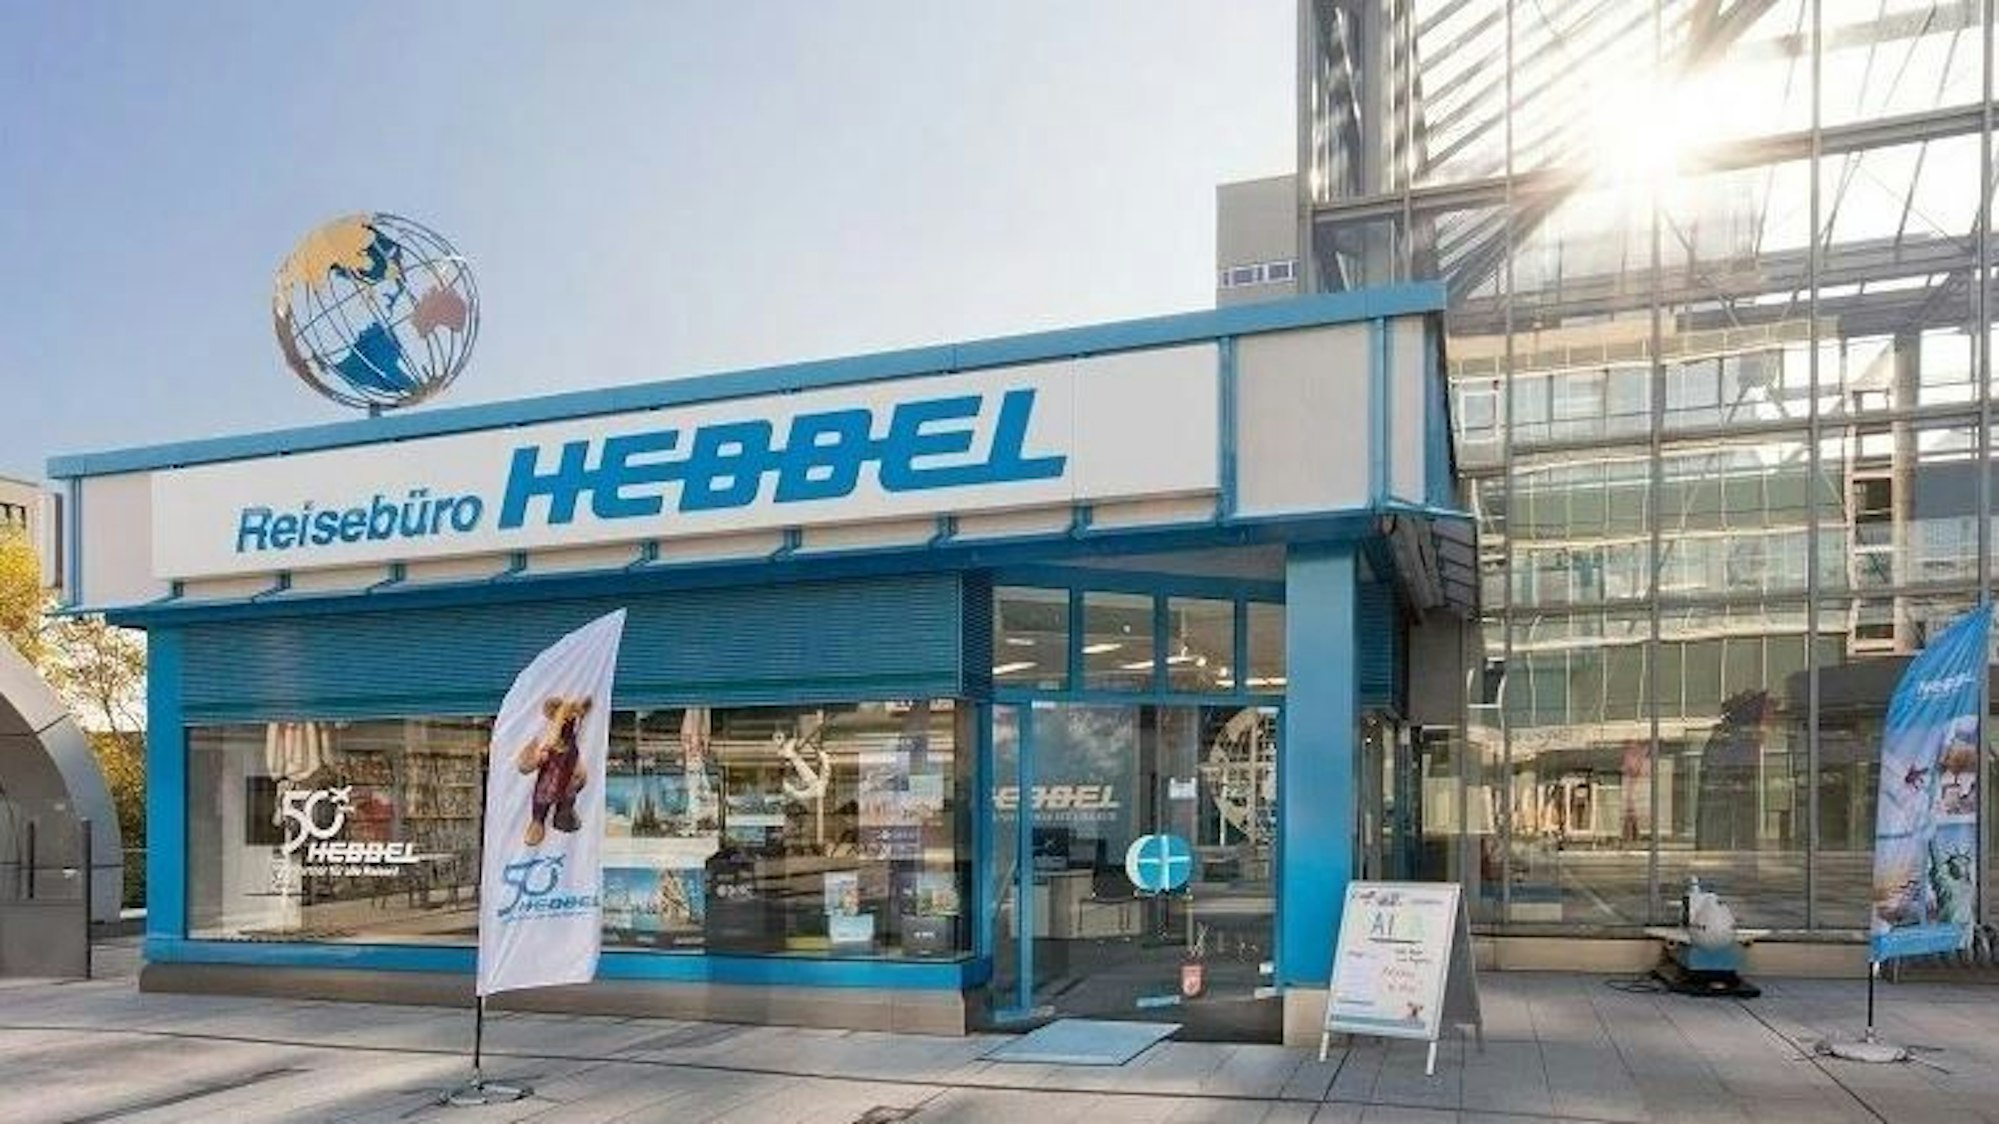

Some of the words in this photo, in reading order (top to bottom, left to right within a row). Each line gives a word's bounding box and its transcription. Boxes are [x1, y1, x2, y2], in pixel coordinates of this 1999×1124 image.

[236, 491, 484, 554] Reisebüro
[498, 388, 1067, 529] HEBBEL
[282, 791, 345, 856] 50
[993, 785, 1119, 808] EBBEL
[307, 842, 421, 864] HEBBEL
[498, 860, 559, 917] 50
